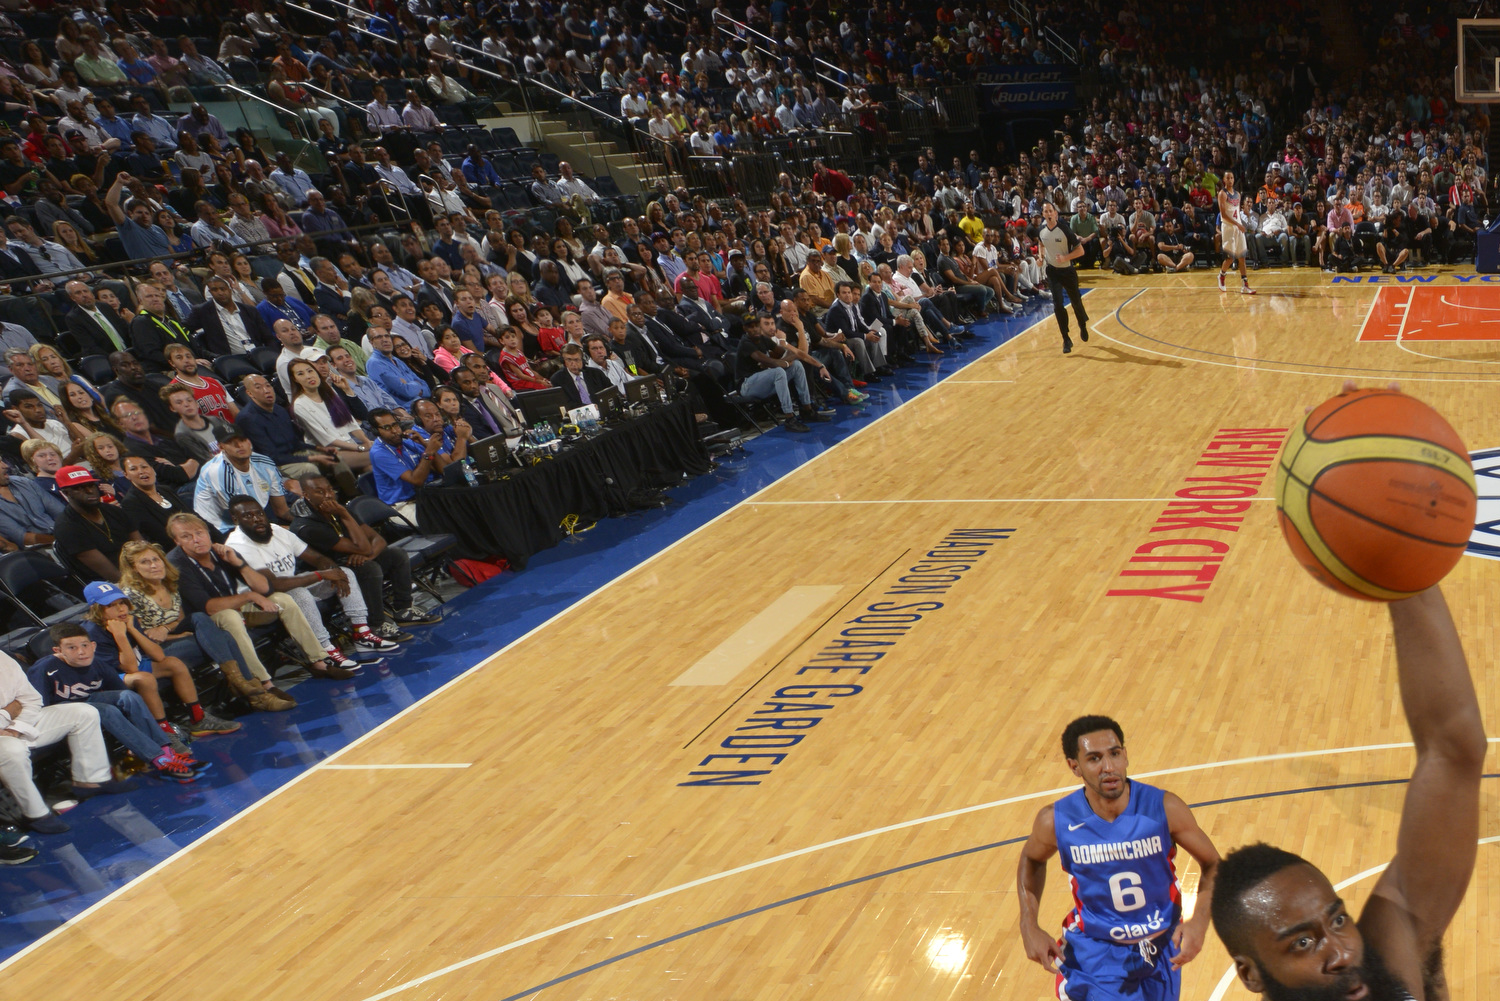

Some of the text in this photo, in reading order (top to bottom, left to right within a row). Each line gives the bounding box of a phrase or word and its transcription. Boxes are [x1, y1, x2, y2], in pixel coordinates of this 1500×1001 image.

[1232, 209, 1238, 220] 4
[1331, 275, 1437, 284] NEW
[197, 395, 228, 414] BULL
[1105, 428, 1290, 603] NEW YORK CITY
[98, 583, 113, 593] D
[676, 528, 1017, 787] MADISON SQUARE GARDEN
[1069, 835, 1162, 865] DOMINICANA
[1108, 871, 1147, 913] 6
[1109, 915, 1162, 941] Claro
